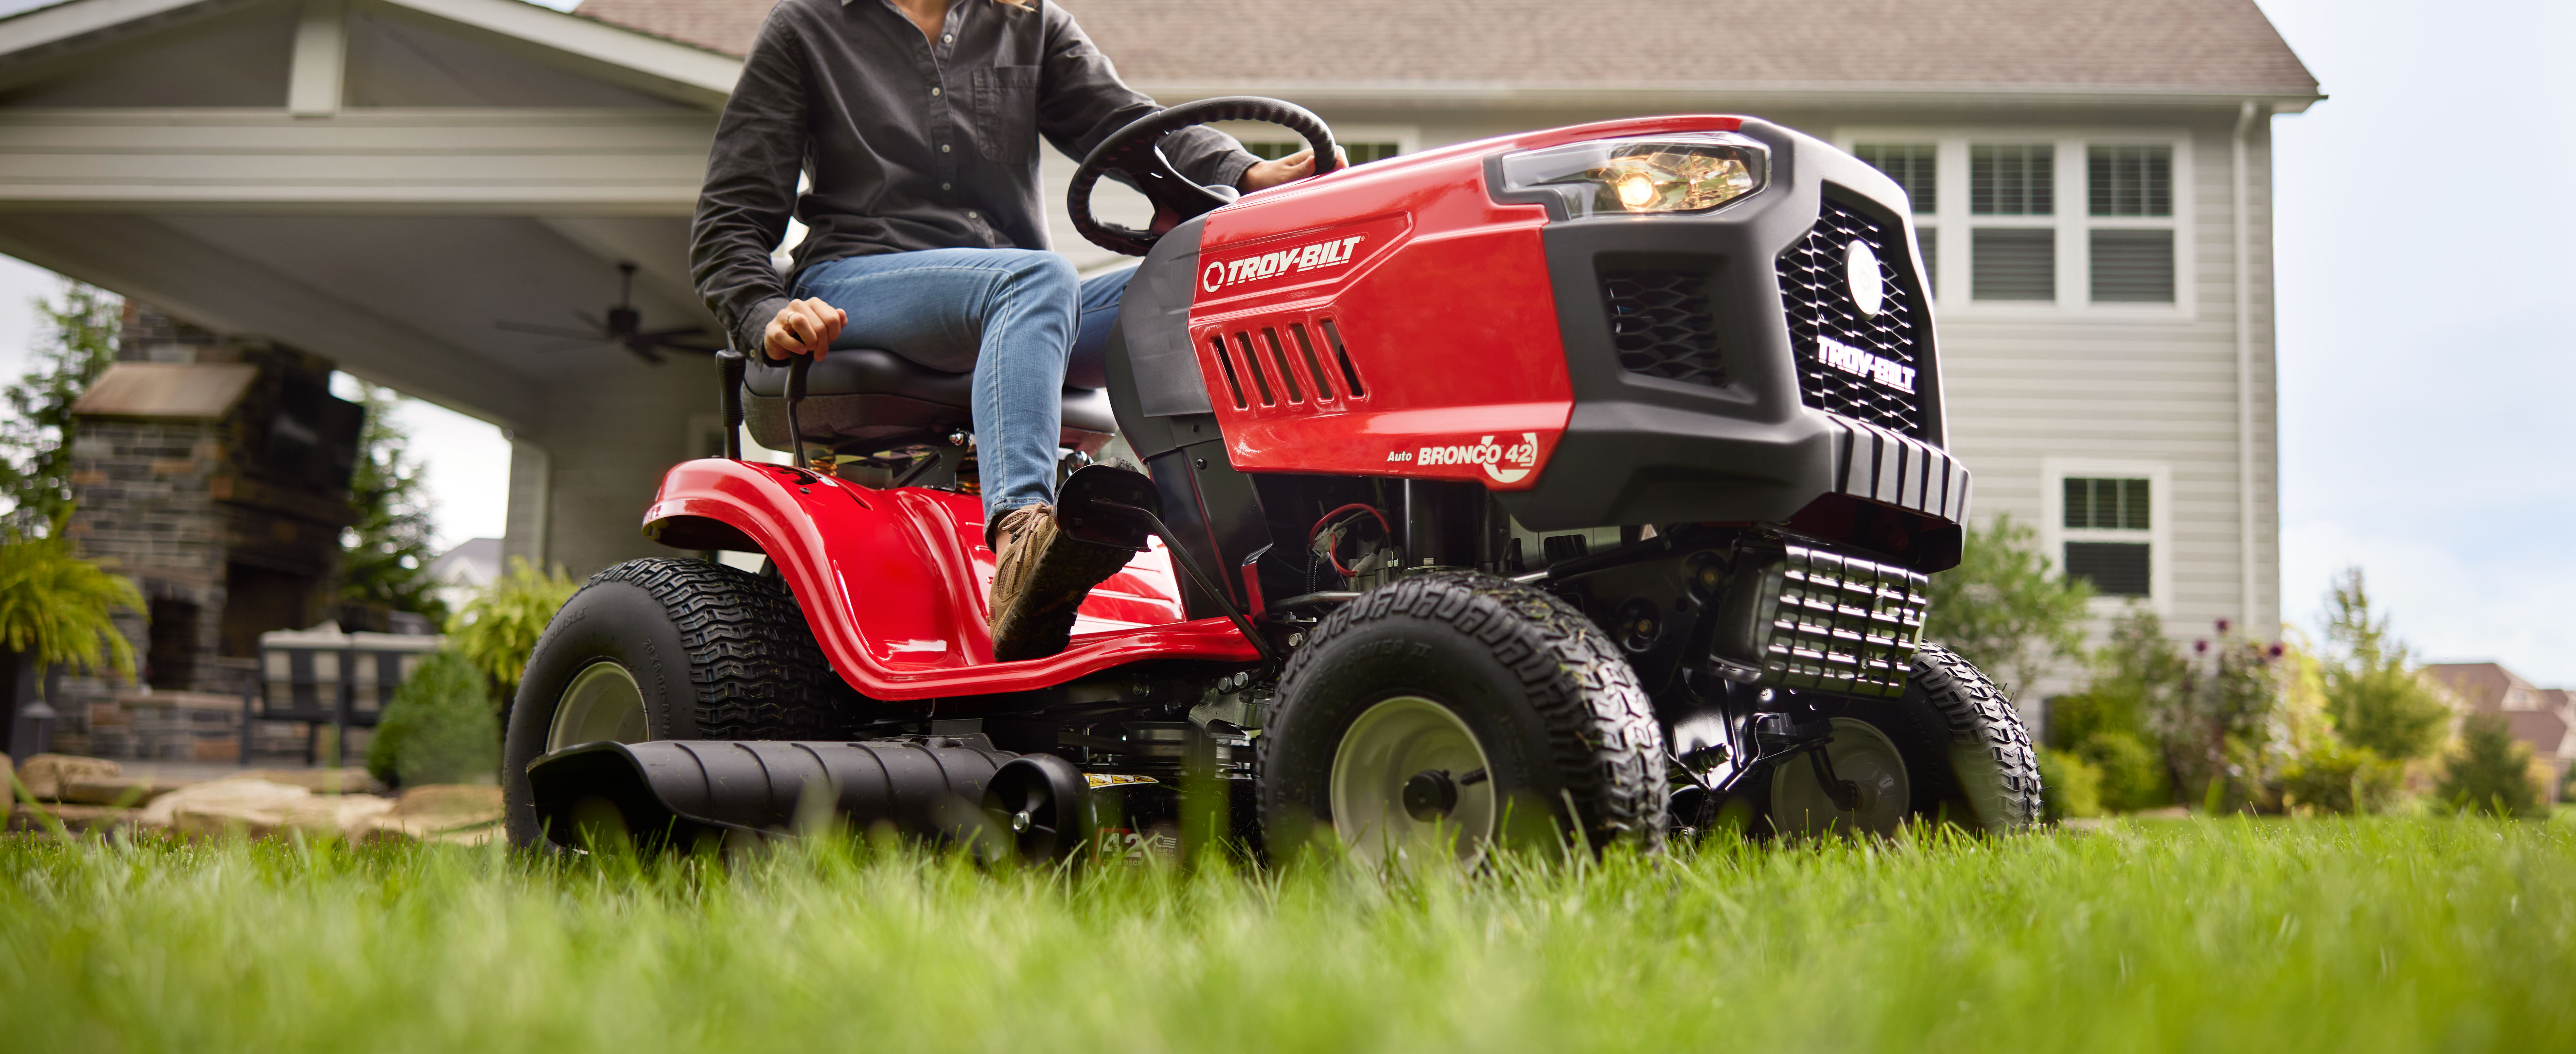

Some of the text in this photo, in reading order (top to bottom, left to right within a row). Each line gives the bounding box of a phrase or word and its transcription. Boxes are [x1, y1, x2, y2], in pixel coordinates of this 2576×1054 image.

[1226, 236, 1361, 286] TROY-BILT
[1817, 335, 1915, 395] TROY-BILT
[1387, 444, 1533, 465] Auto BRONCO 42
[1103, 833, 1142, 858] 42
